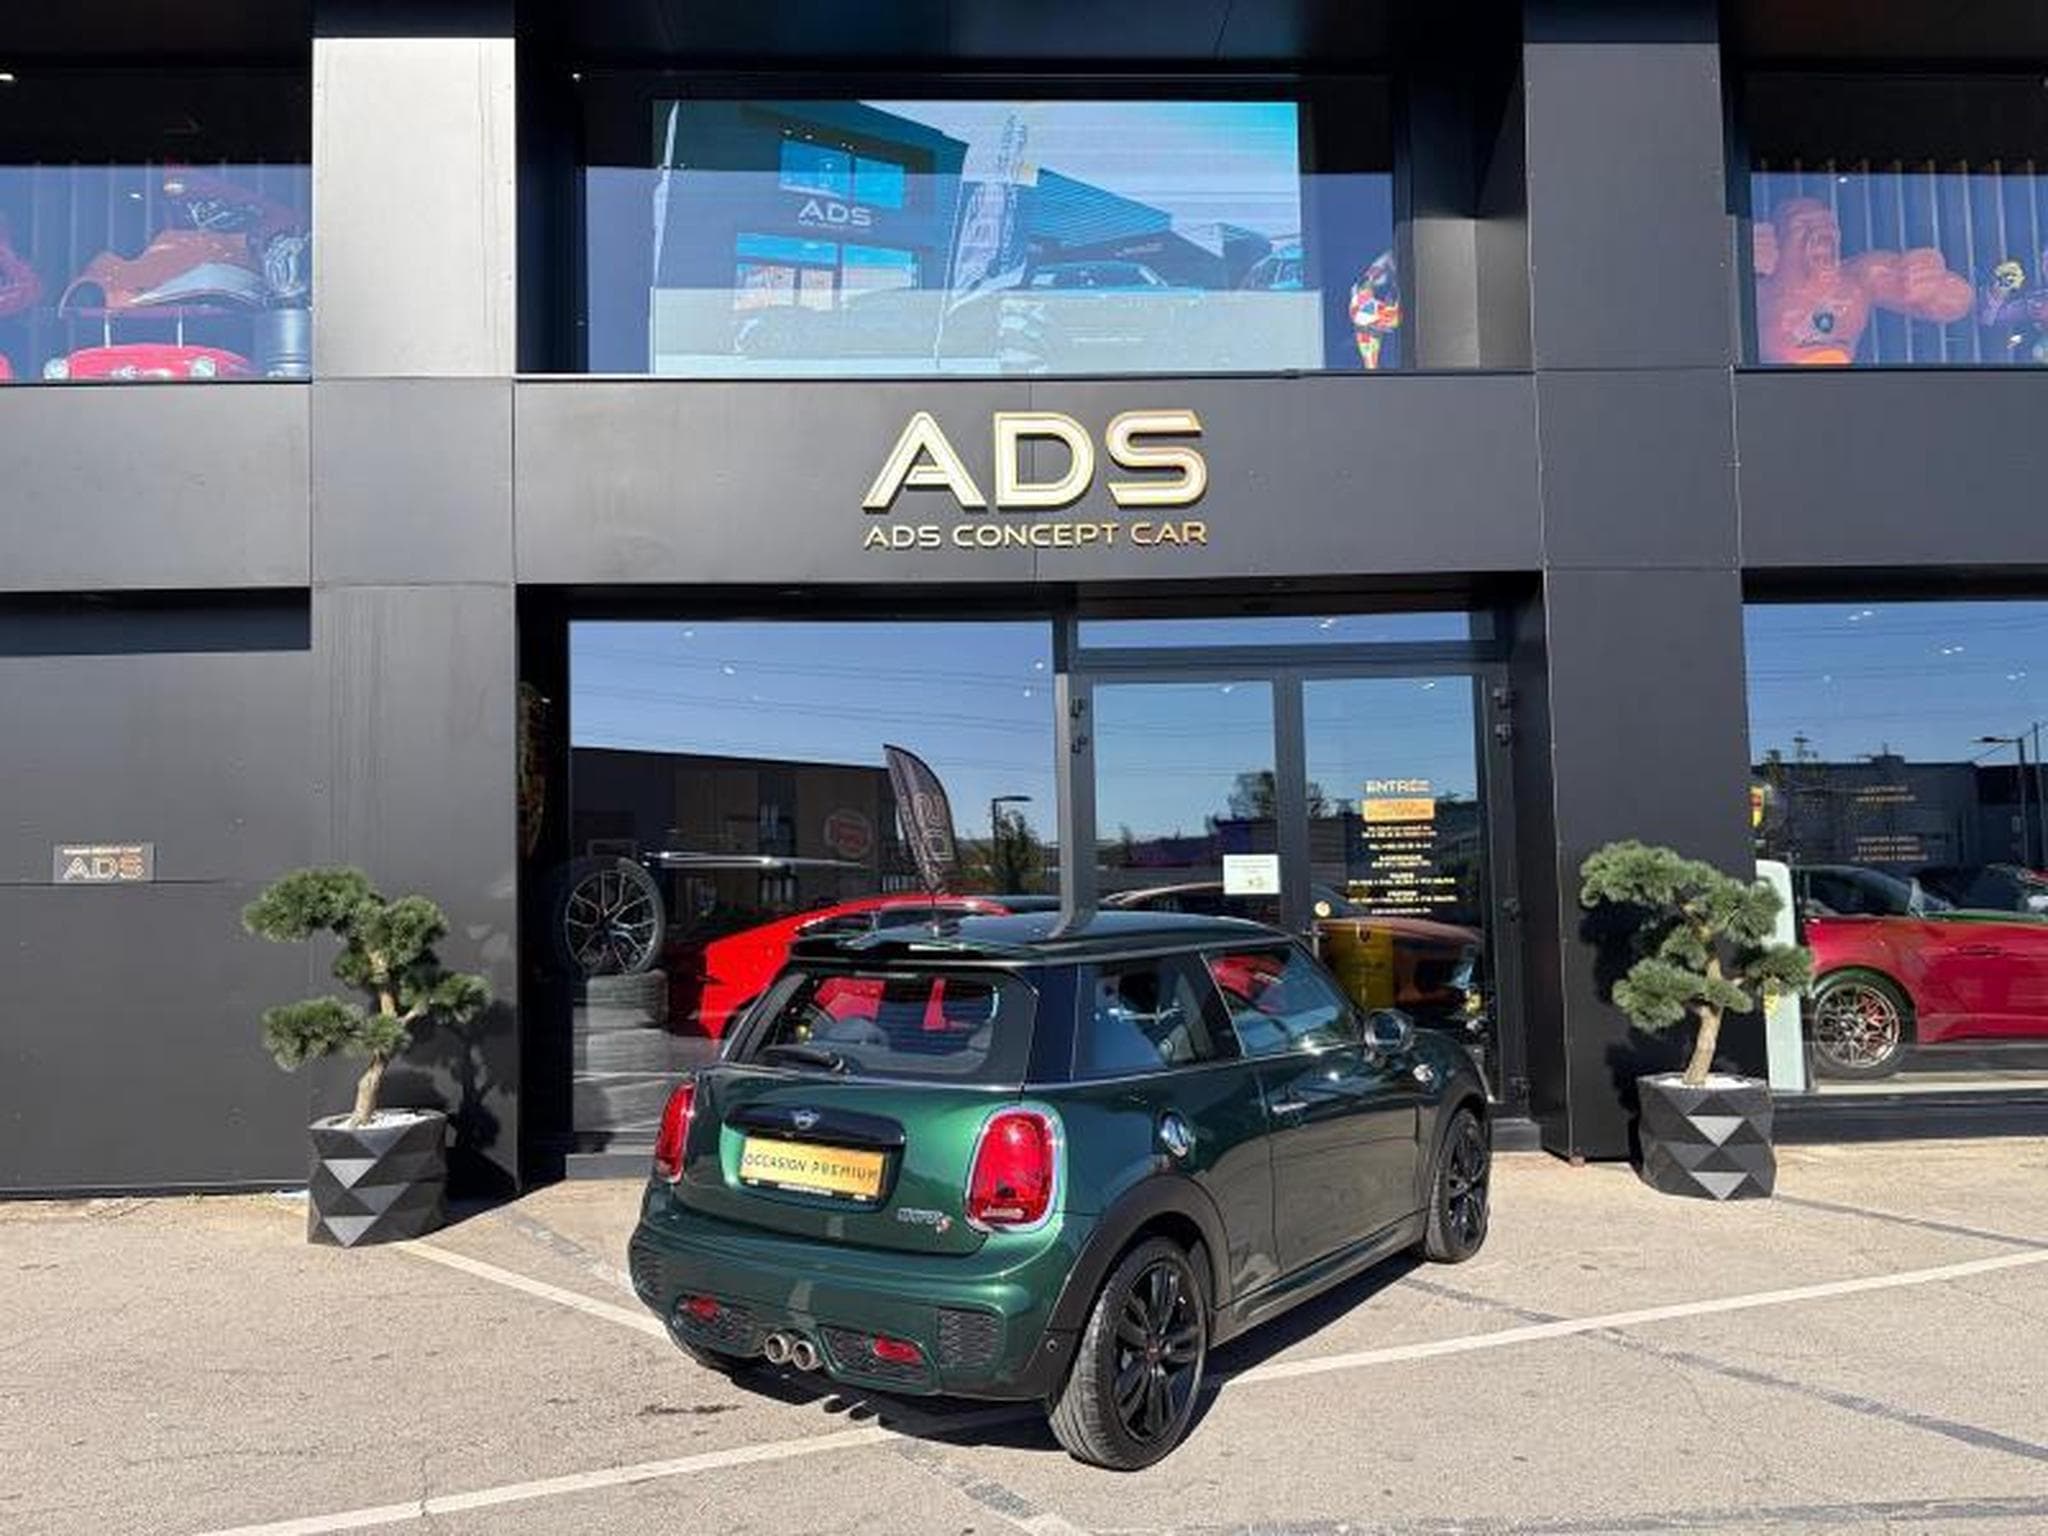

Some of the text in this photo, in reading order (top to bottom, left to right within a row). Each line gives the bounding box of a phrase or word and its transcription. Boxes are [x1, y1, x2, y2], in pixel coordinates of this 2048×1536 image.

[798, 199, 872, 227] ADS
[861, 410, 1207, 511] ADS
[863, 521, 1208, 549] ADS CONCEPT CAR
[63, 856, 144, 880] ADS
[744, 1154, 879, 1180] OCCASION PREMIUM
